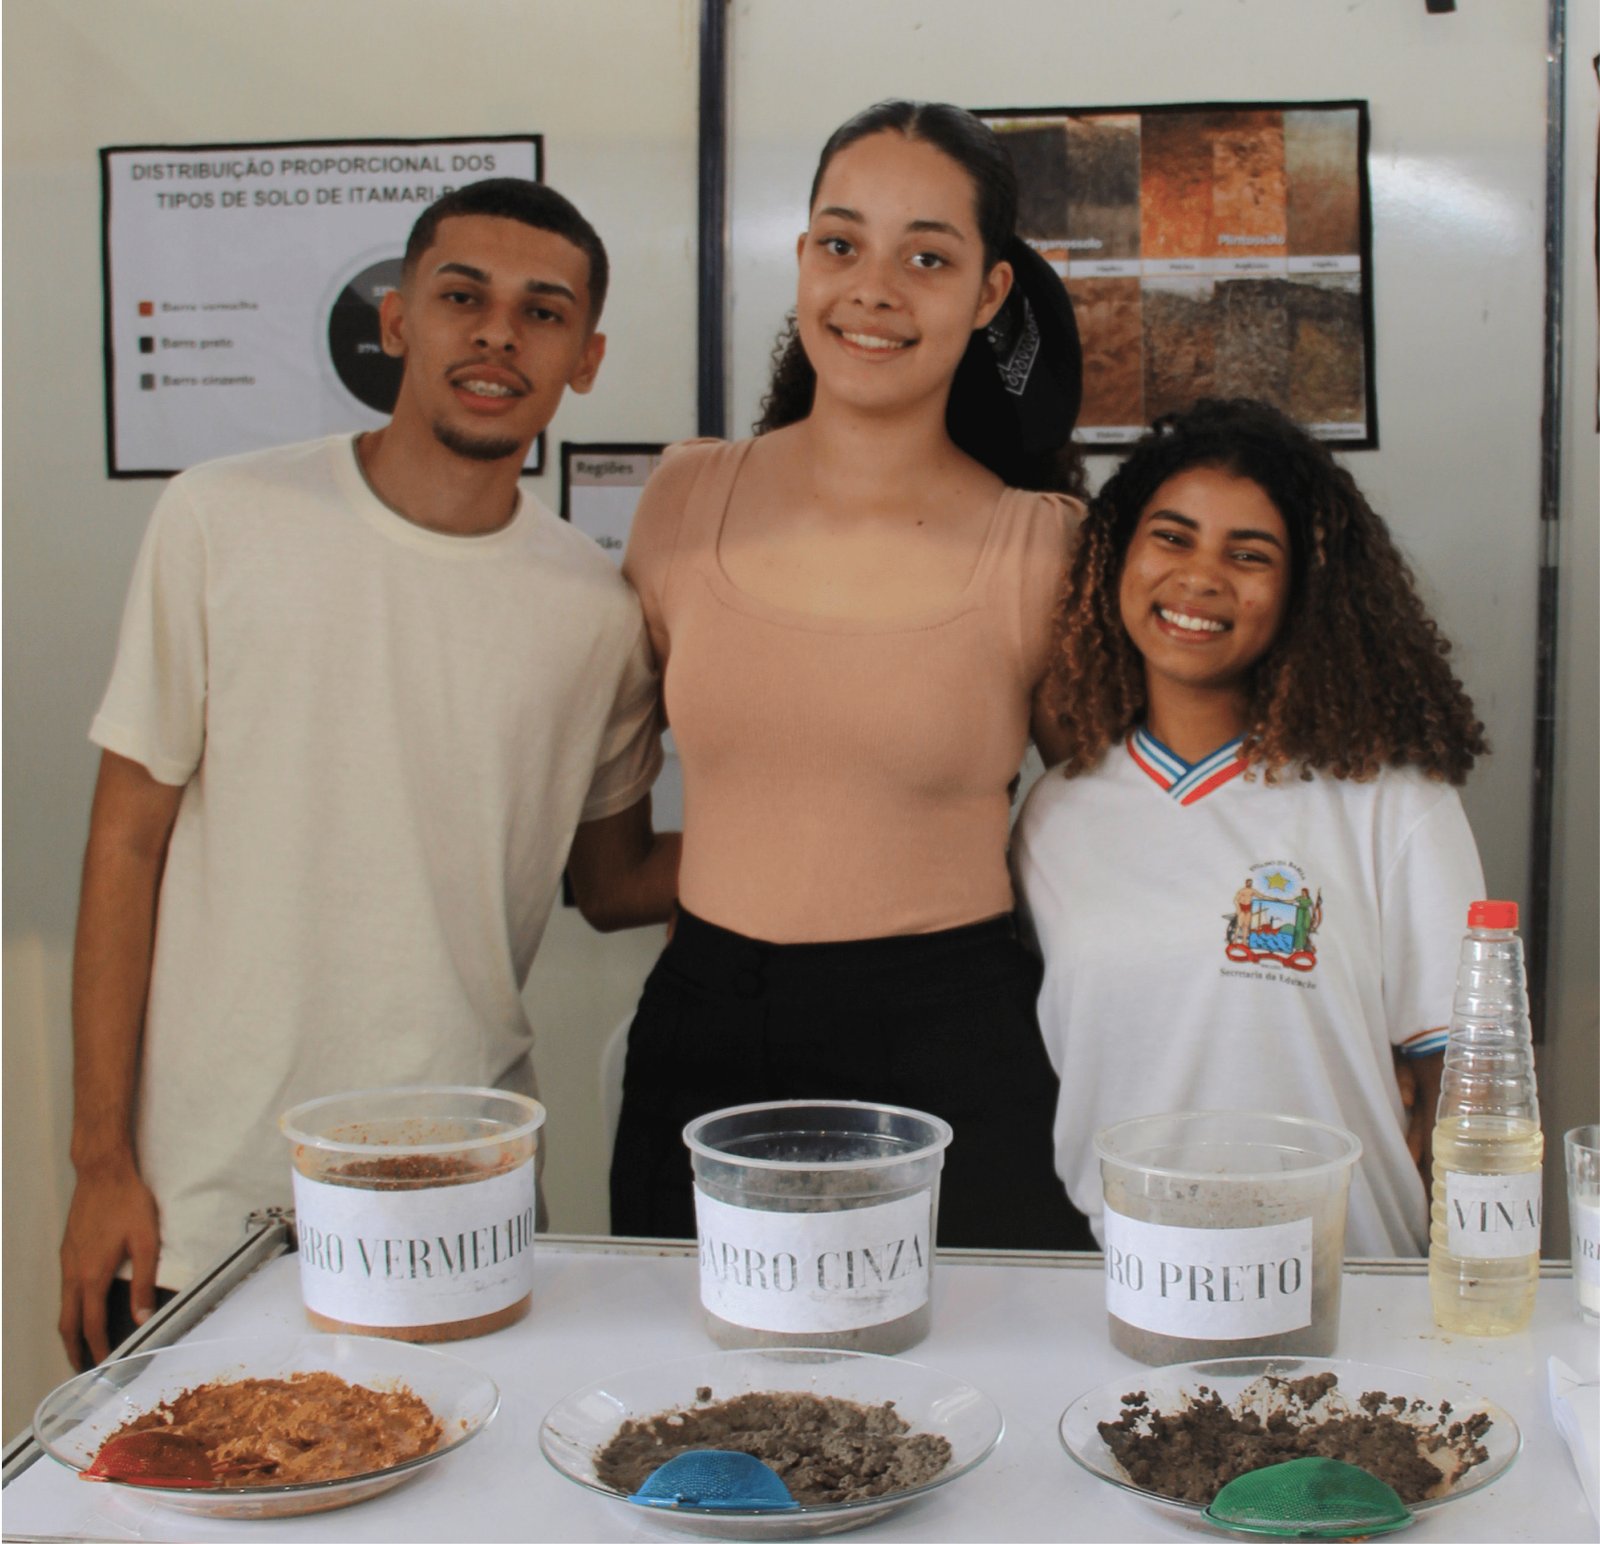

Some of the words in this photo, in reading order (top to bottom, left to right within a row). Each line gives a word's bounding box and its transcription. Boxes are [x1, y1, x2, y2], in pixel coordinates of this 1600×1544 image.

[131, 157, 274, 181] DISTRIBUIÇÃO
[280, 156, 445, 176] PROPORCIONAL
[451, 154, 496, 172] DOS
[157, 191, 215, 209] TIPOS
[221, 190, 248, 208] DE
[253, 188, 309, 207] SOLO
[316, 187, 342, 205] DE
[576, 460, 634, 478] Regiões
[1265, 972, 1277, 981] da
[356, 1206, 533, 1280] VERMELHO
[816, 1233, 924, 1292] CINZA
[1159, 1256, 1302, 1303] PRETO
